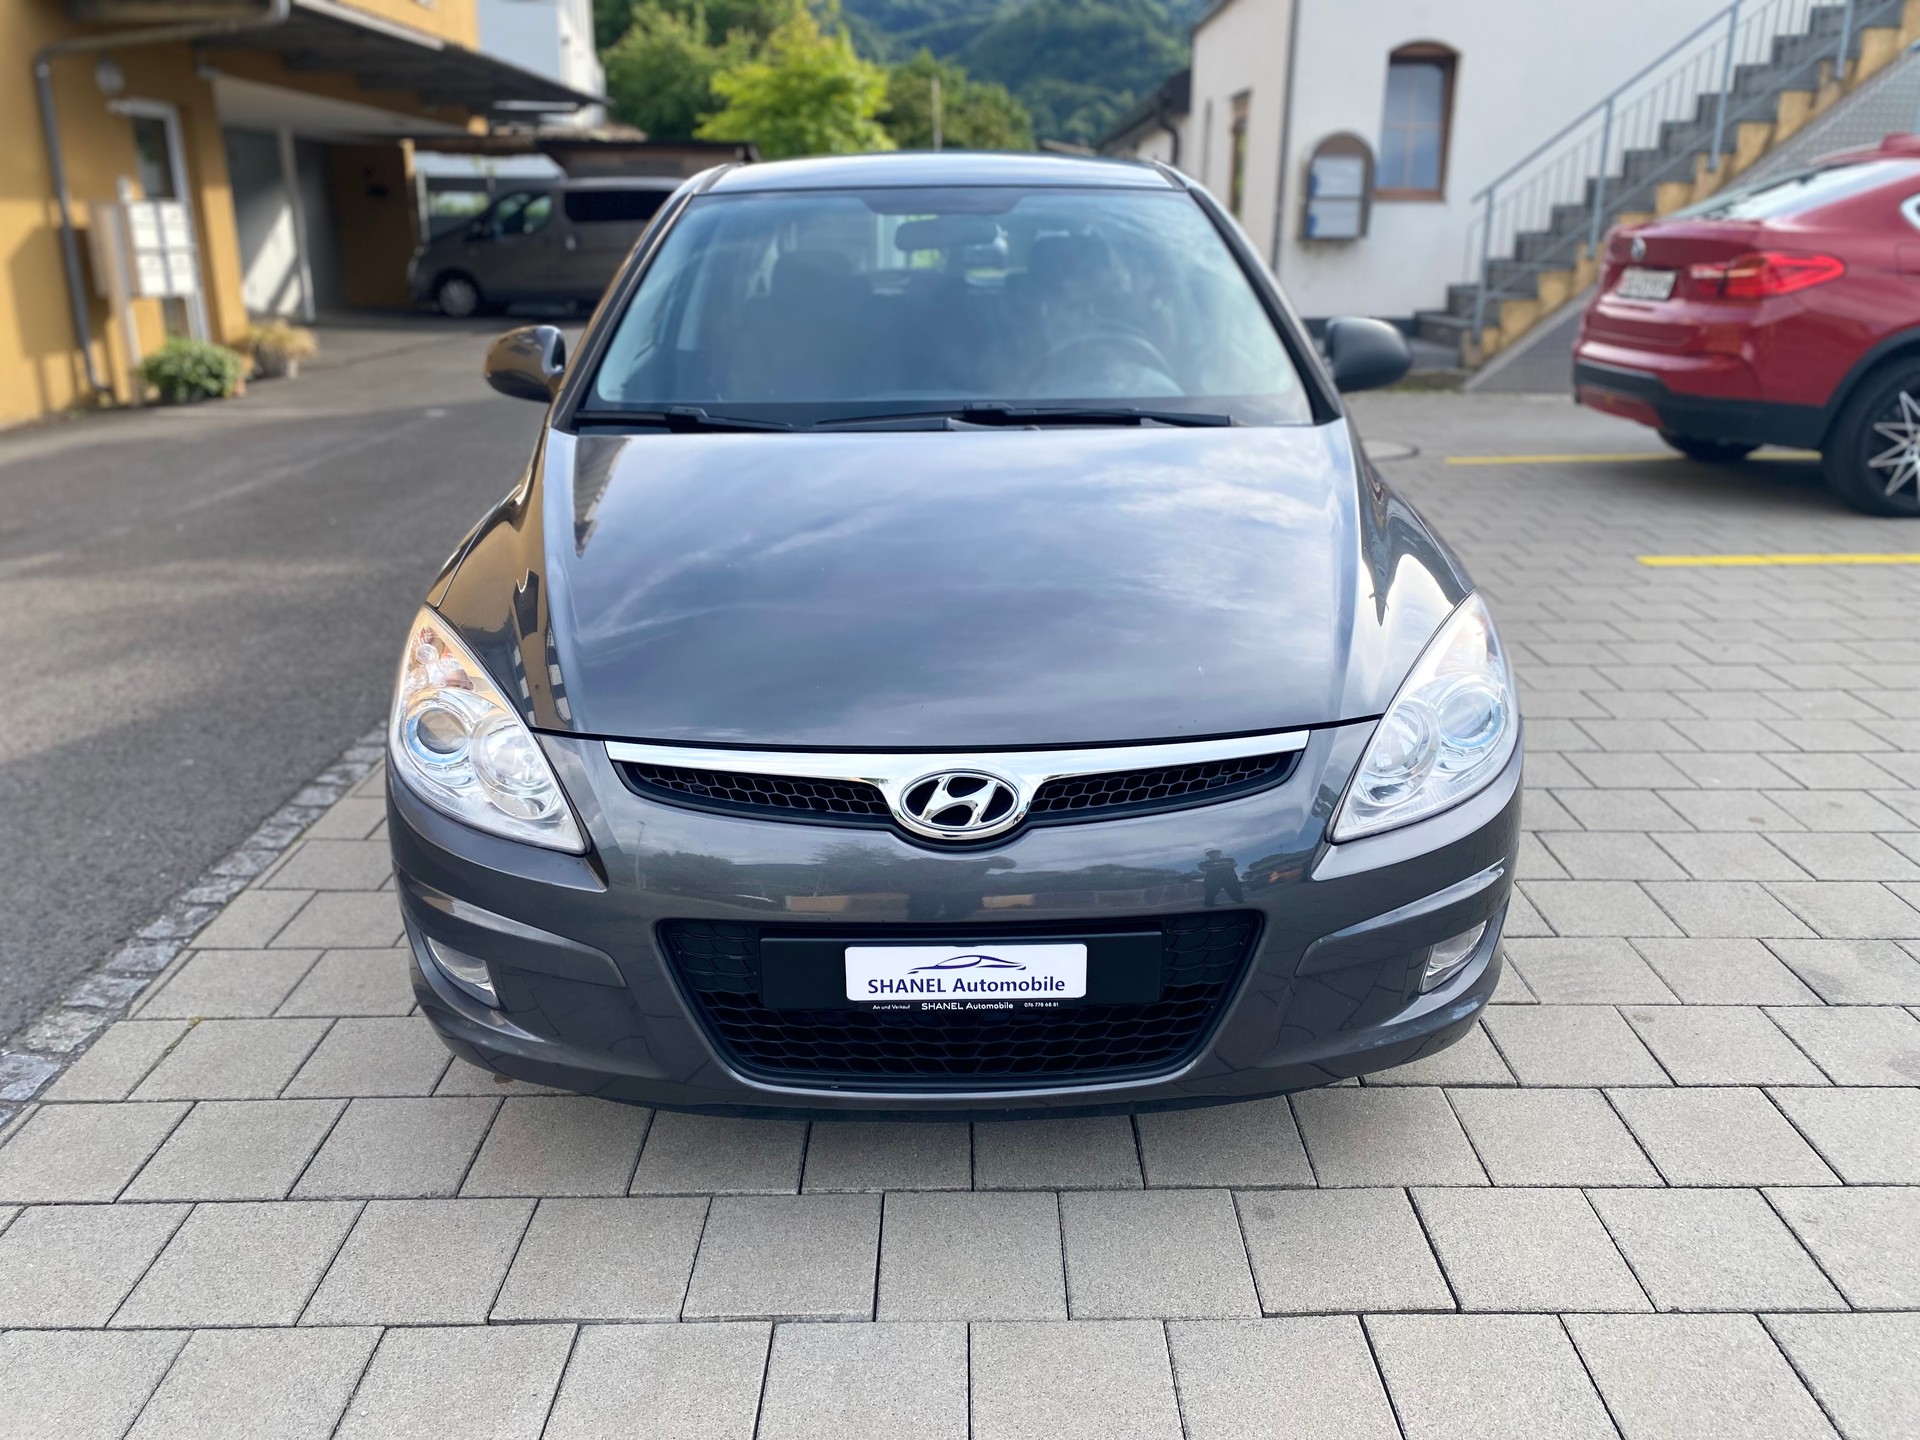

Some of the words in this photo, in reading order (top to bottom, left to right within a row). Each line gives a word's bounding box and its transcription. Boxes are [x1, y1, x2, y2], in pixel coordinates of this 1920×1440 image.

[868, 978, 946, 994] SHANEL
[952, 976, 1066, 993] Automobile
[921, 1002, 964, 1010] SHANEL
[965, 1001, 1014, 1010] Automobile
